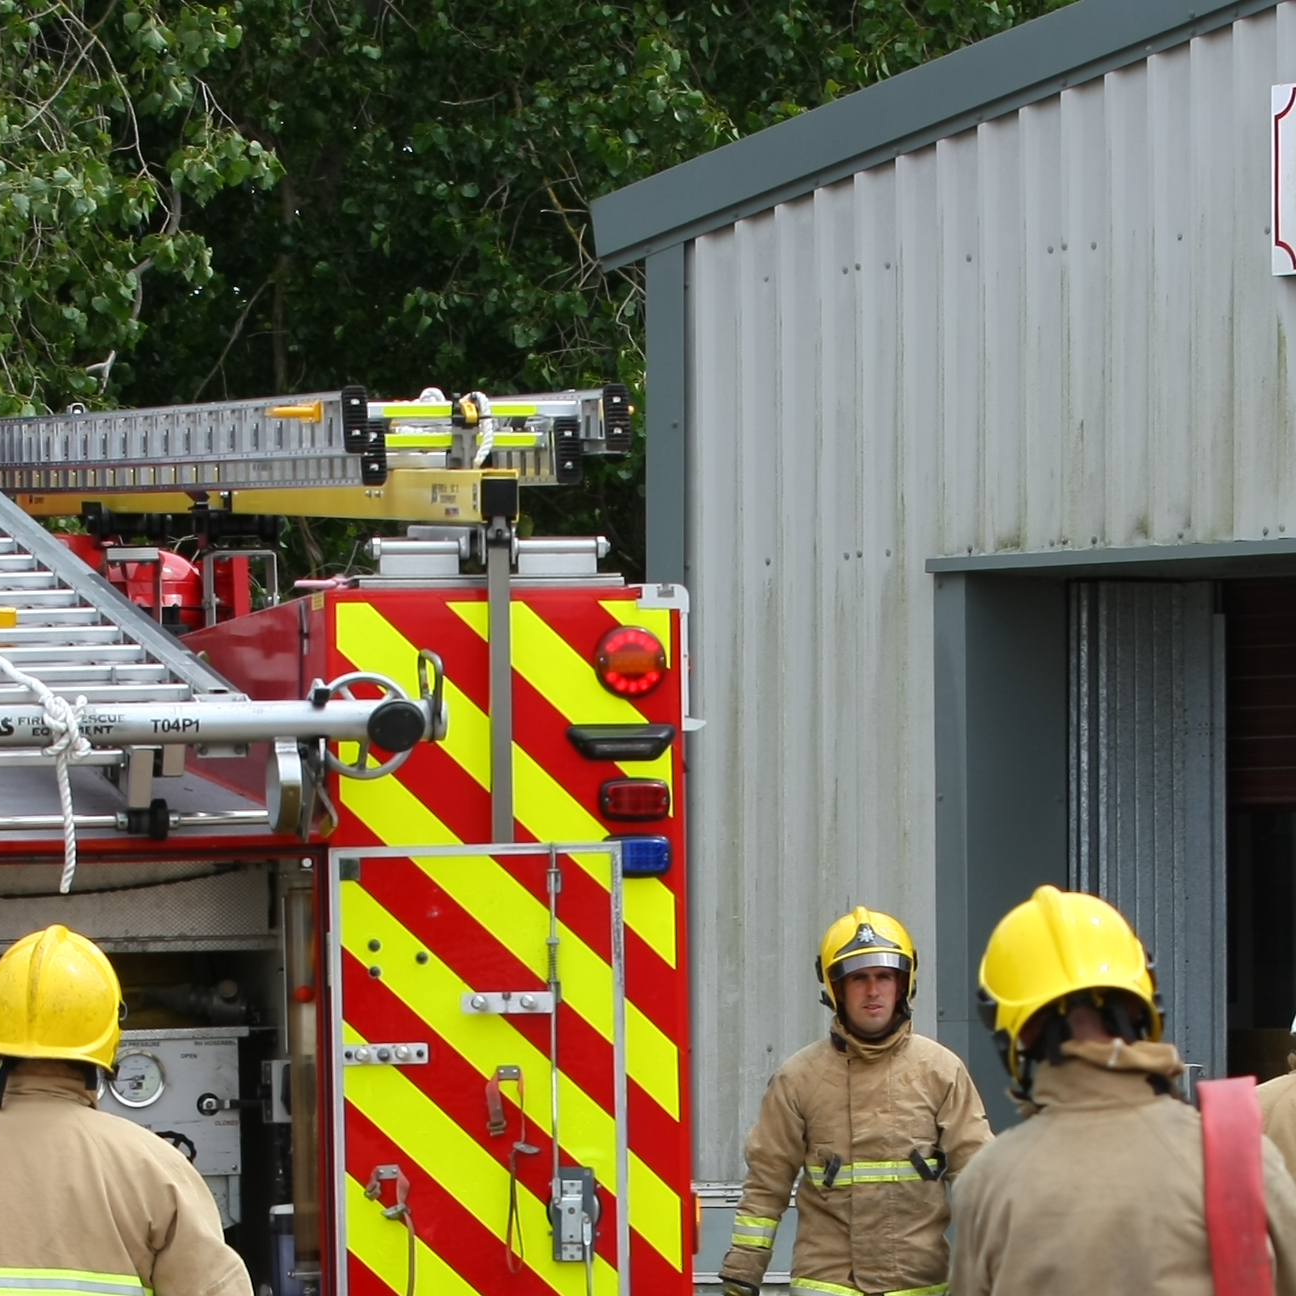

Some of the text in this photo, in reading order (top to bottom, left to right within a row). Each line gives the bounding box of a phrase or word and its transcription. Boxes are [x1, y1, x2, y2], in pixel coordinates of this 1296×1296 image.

[18, 713, 126, 726] FIR ESCUE
[150, 718, 200, 734] T04P1
